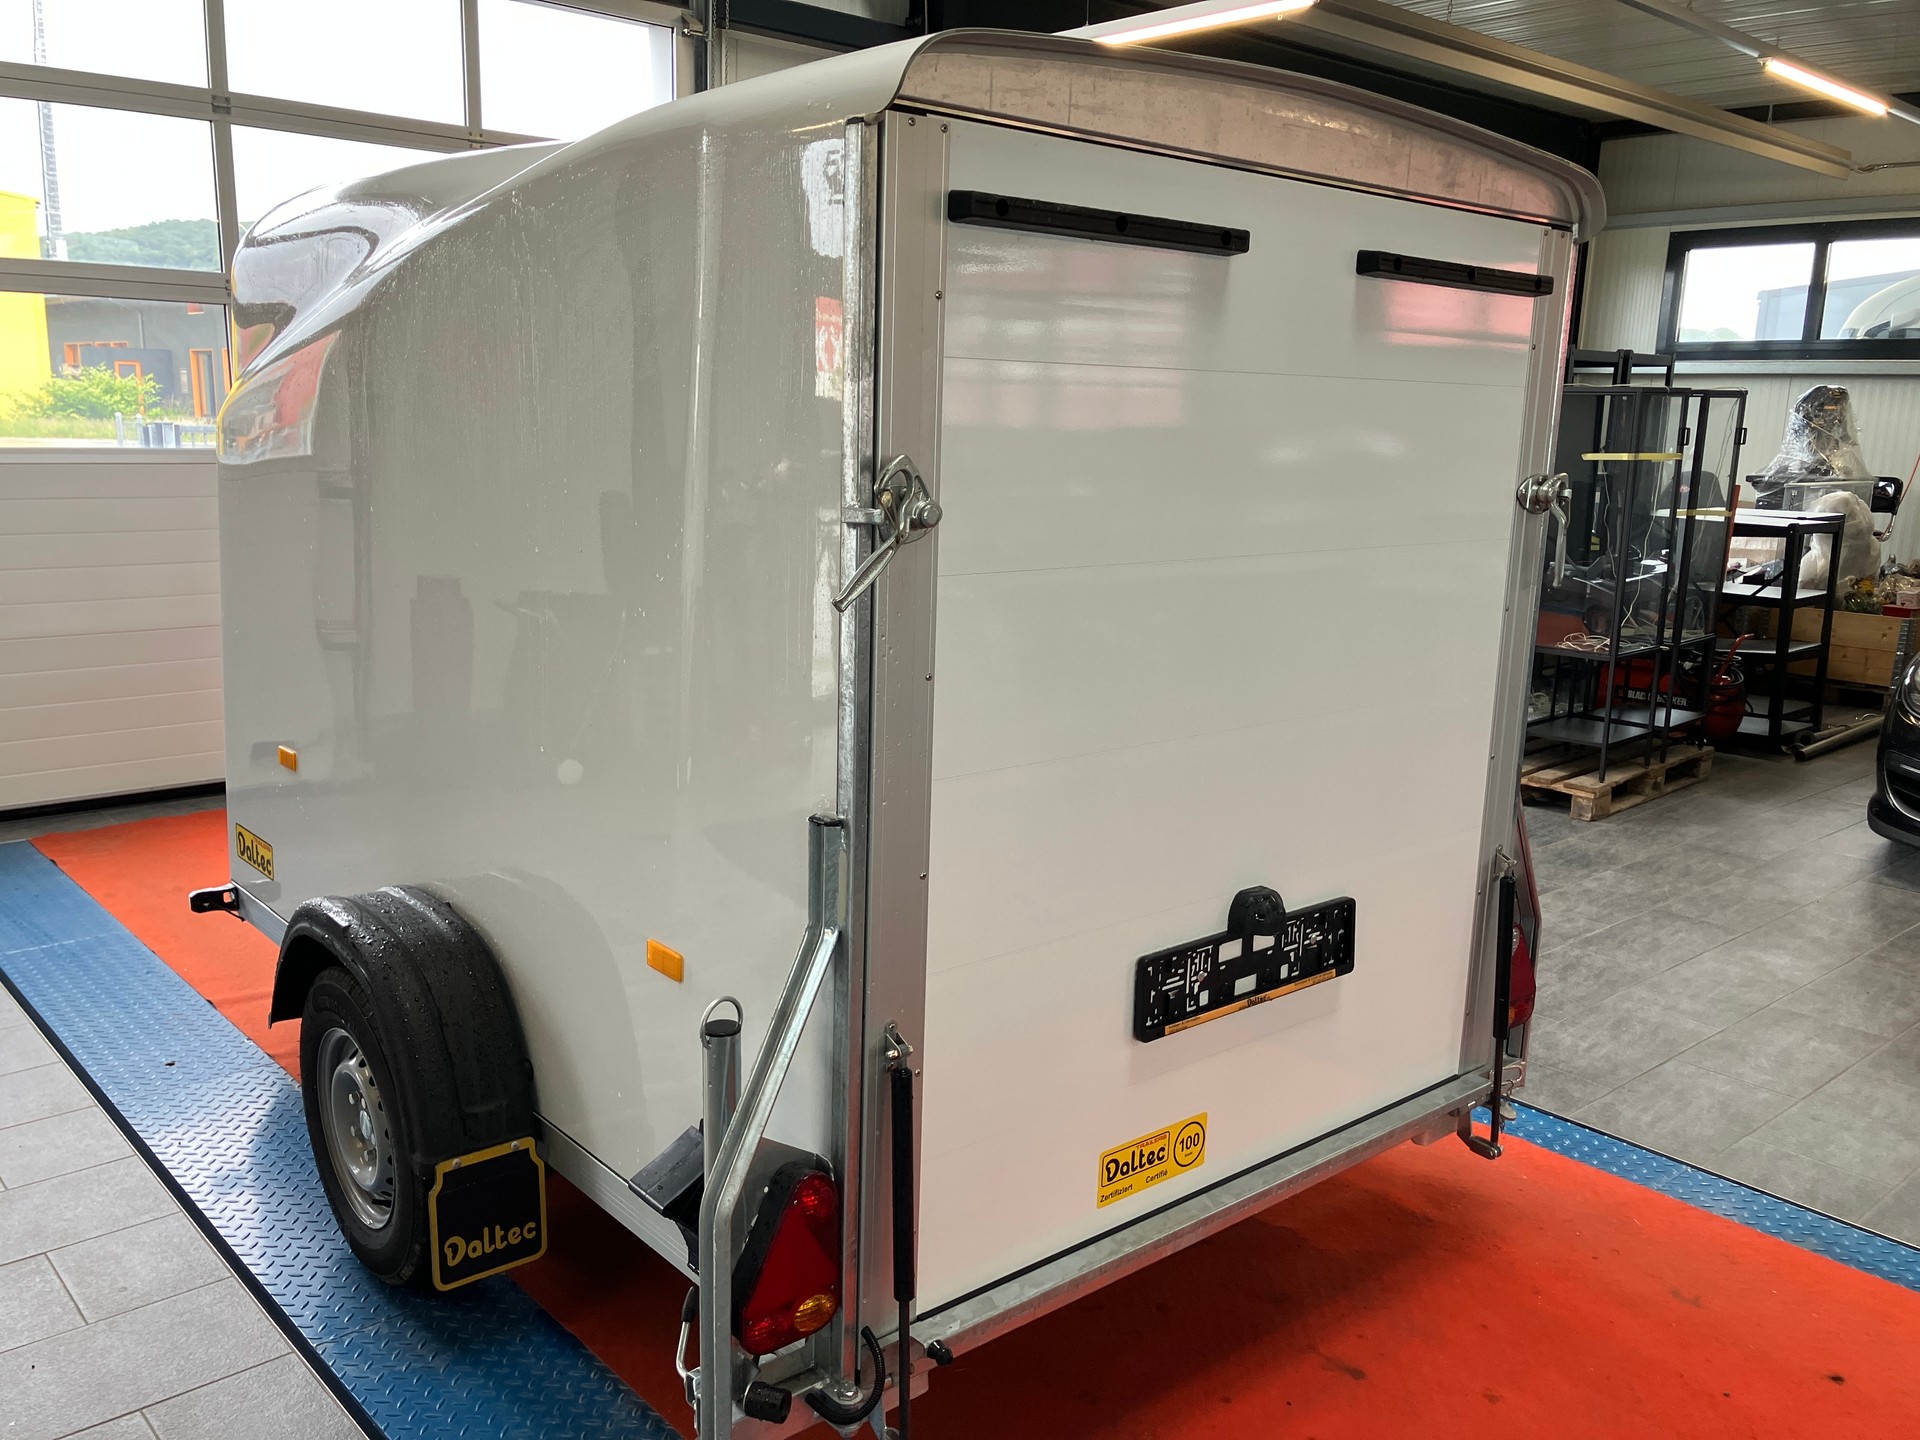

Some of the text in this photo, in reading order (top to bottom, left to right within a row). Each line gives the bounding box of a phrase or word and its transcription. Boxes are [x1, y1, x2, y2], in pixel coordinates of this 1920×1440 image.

[237, 831, 271, 876] Daltec
[1180, 1132, 1200, 1152] 100
[1105, 1146, 1166, 1182] Daltec
[1100, 1184, 1133, 1203] Zertifiziert
[444, 1221, 536, 1267] Daltec
